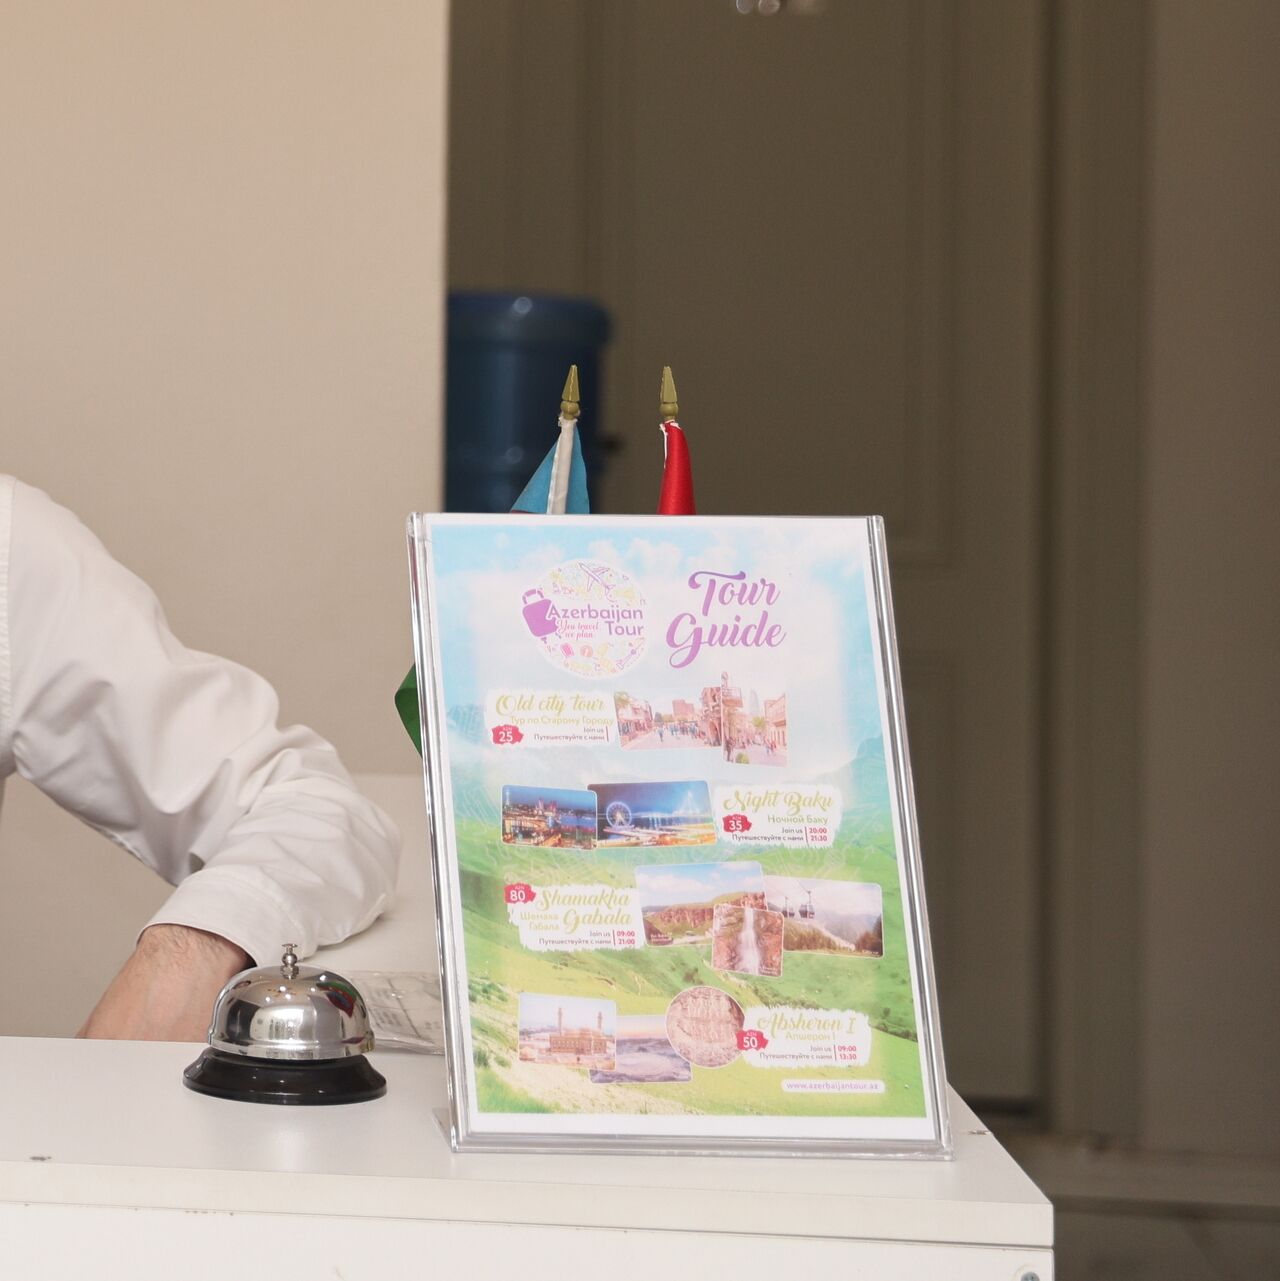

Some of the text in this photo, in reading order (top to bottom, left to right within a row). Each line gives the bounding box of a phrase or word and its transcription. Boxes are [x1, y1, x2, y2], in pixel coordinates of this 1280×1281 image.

[688, 571, 781, 617] Tour
[548, 604, 643, 623] Azerbaijan
[604, 621, 644, 636] Tour
[666, 610, 787, 668] Guide
[496, 694, 605, 716] Old city tour
[498, 731, 513, 742] 25
[723, 790, 833, 816] Night Baku
[729, 820, 743, 830] 35
[510, 890, 525, 901] 80
[537, 889, 630, 911] Shamakha
[563, 907, 632, 934] Gabala
[757, 1012, 844, 1039] Absheron
[743, 1037, 758, 1048] 50
